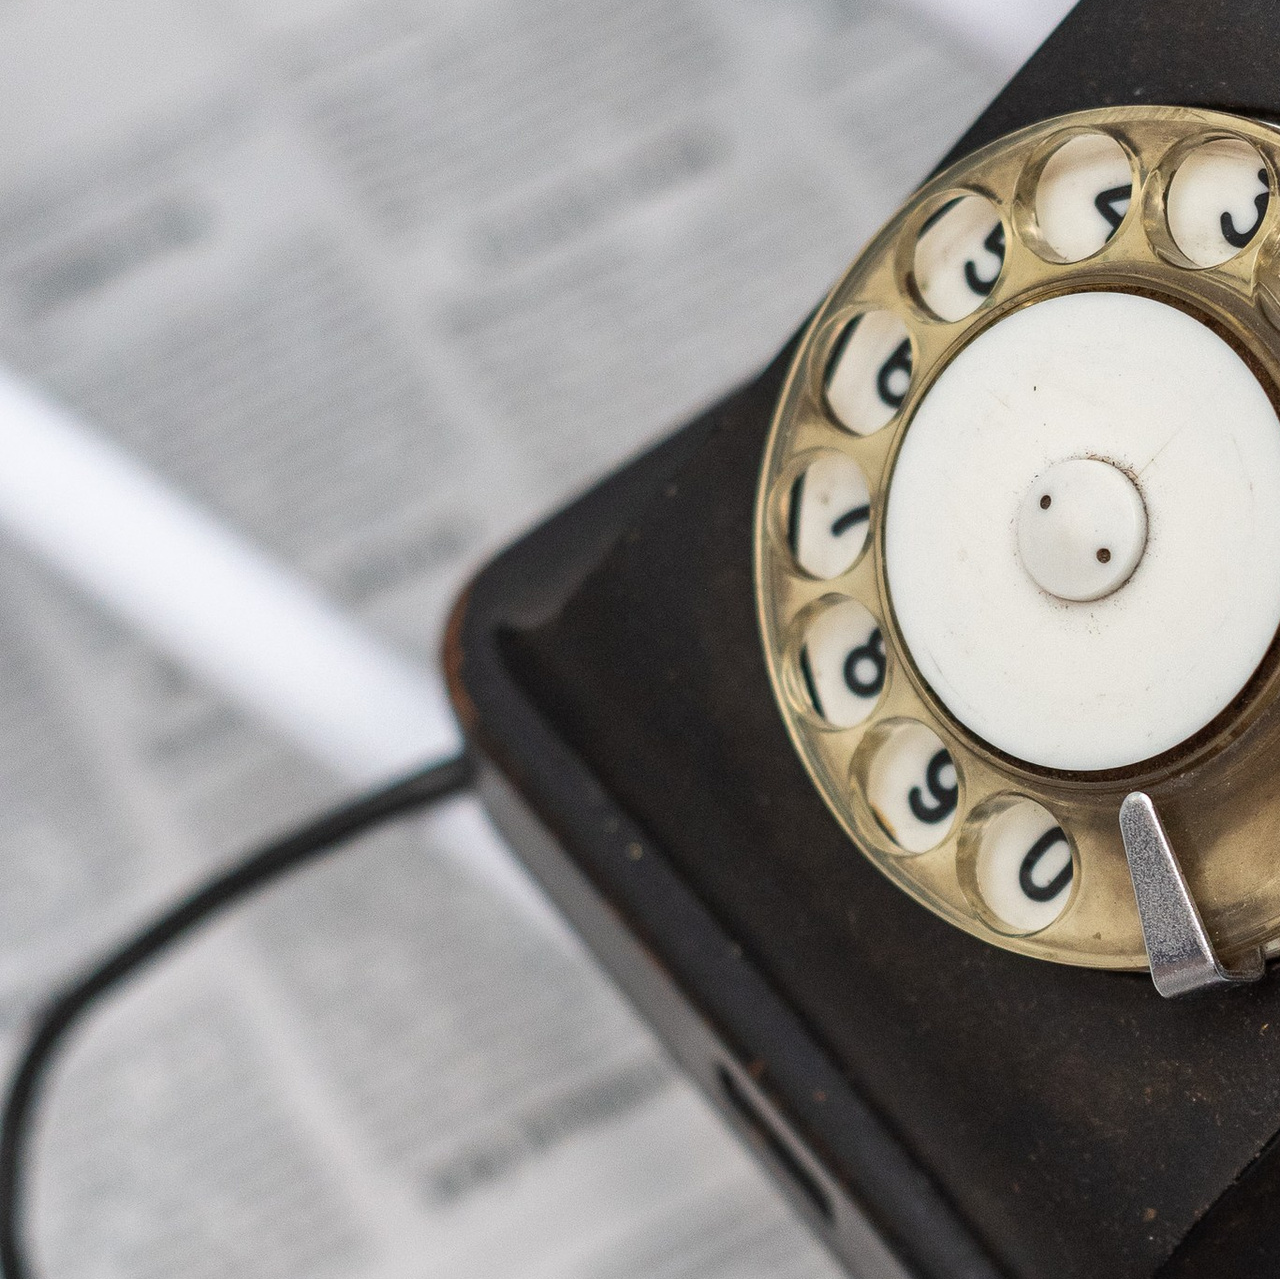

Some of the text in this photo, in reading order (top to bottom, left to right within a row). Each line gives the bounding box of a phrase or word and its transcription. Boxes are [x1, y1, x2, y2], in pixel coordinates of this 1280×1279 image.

[1220, 168, 1269, 248] 3
[843, 626, 887, 698] 8
[908, 747, 959, 824] 9
[1019, 825, 1074, 903] 0
